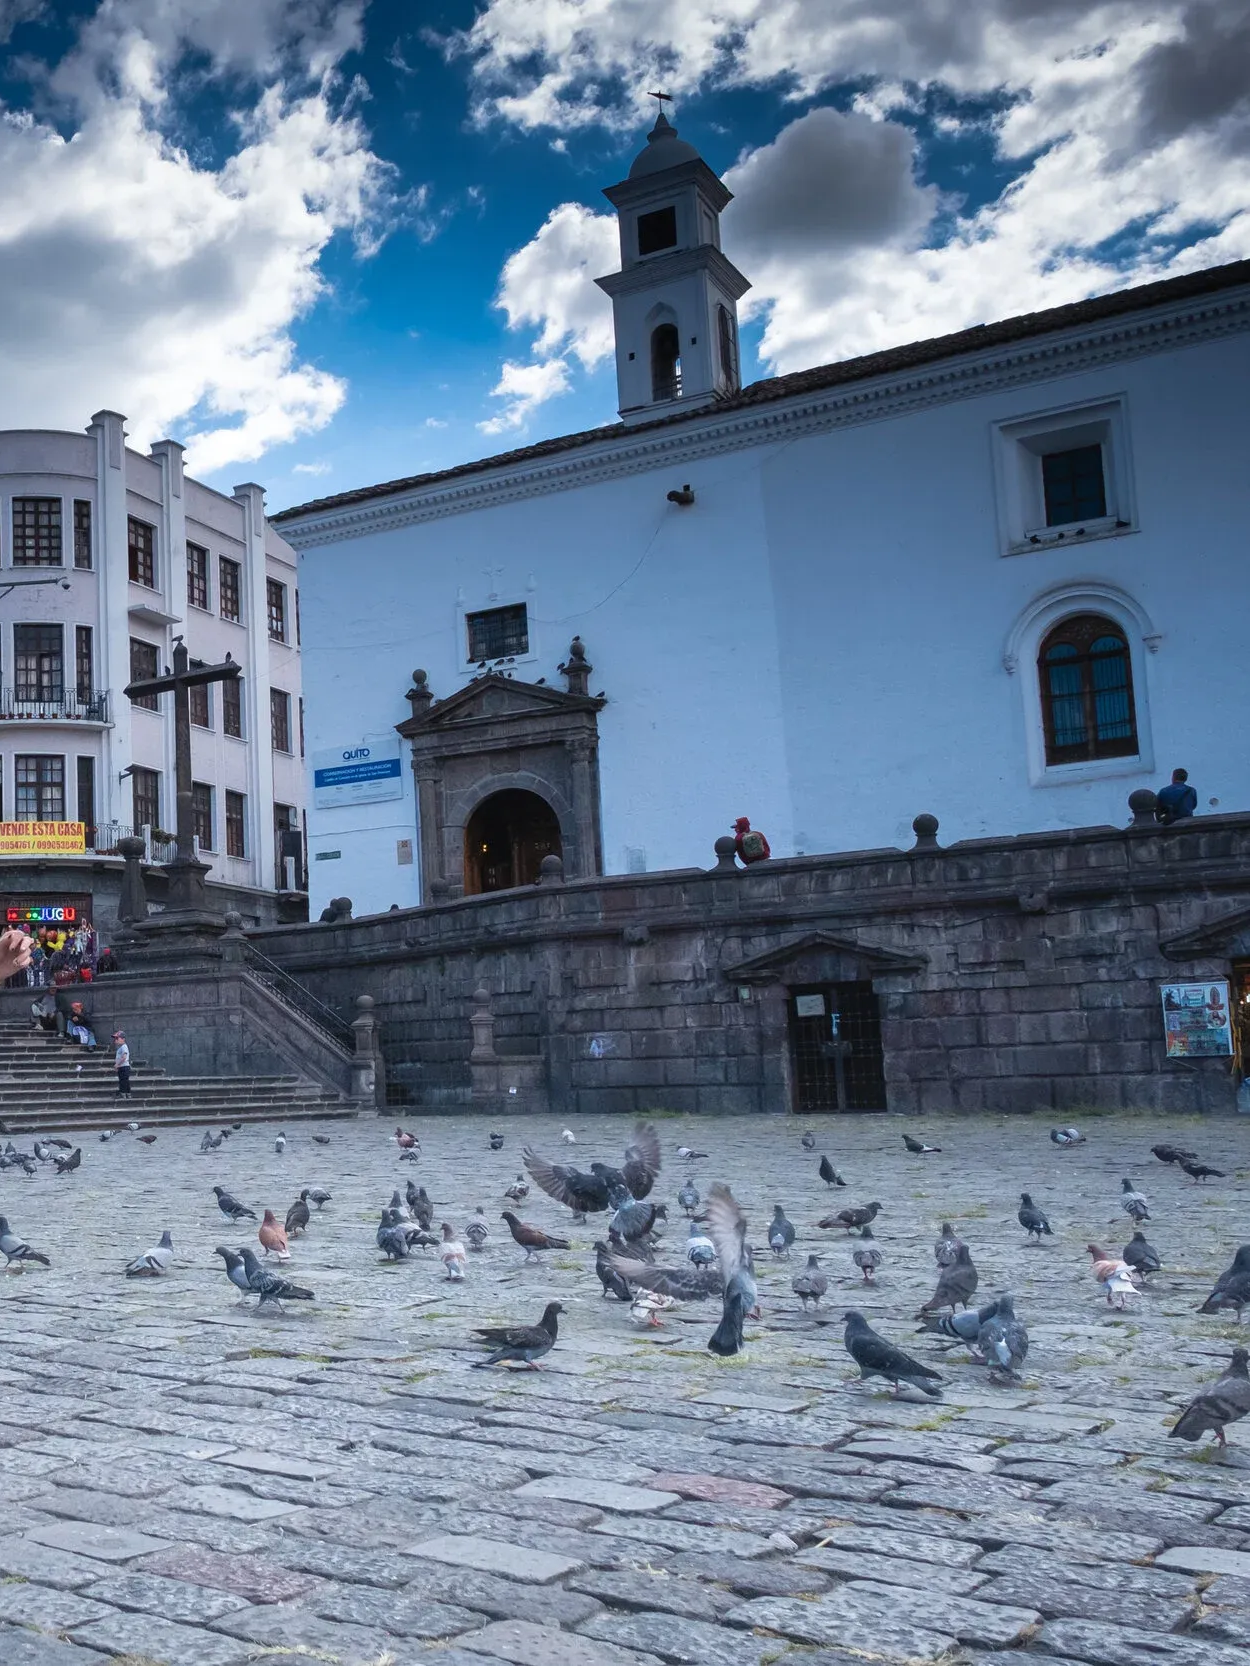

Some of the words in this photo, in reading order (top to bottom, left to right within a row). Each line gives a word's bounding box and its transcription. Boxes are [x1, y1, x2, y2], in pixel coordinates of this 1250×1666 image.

[0, 823, 30, 836] VENDE
[32, 823, 56, 836] ESTA
[58, 823, 83, 836] CASA
